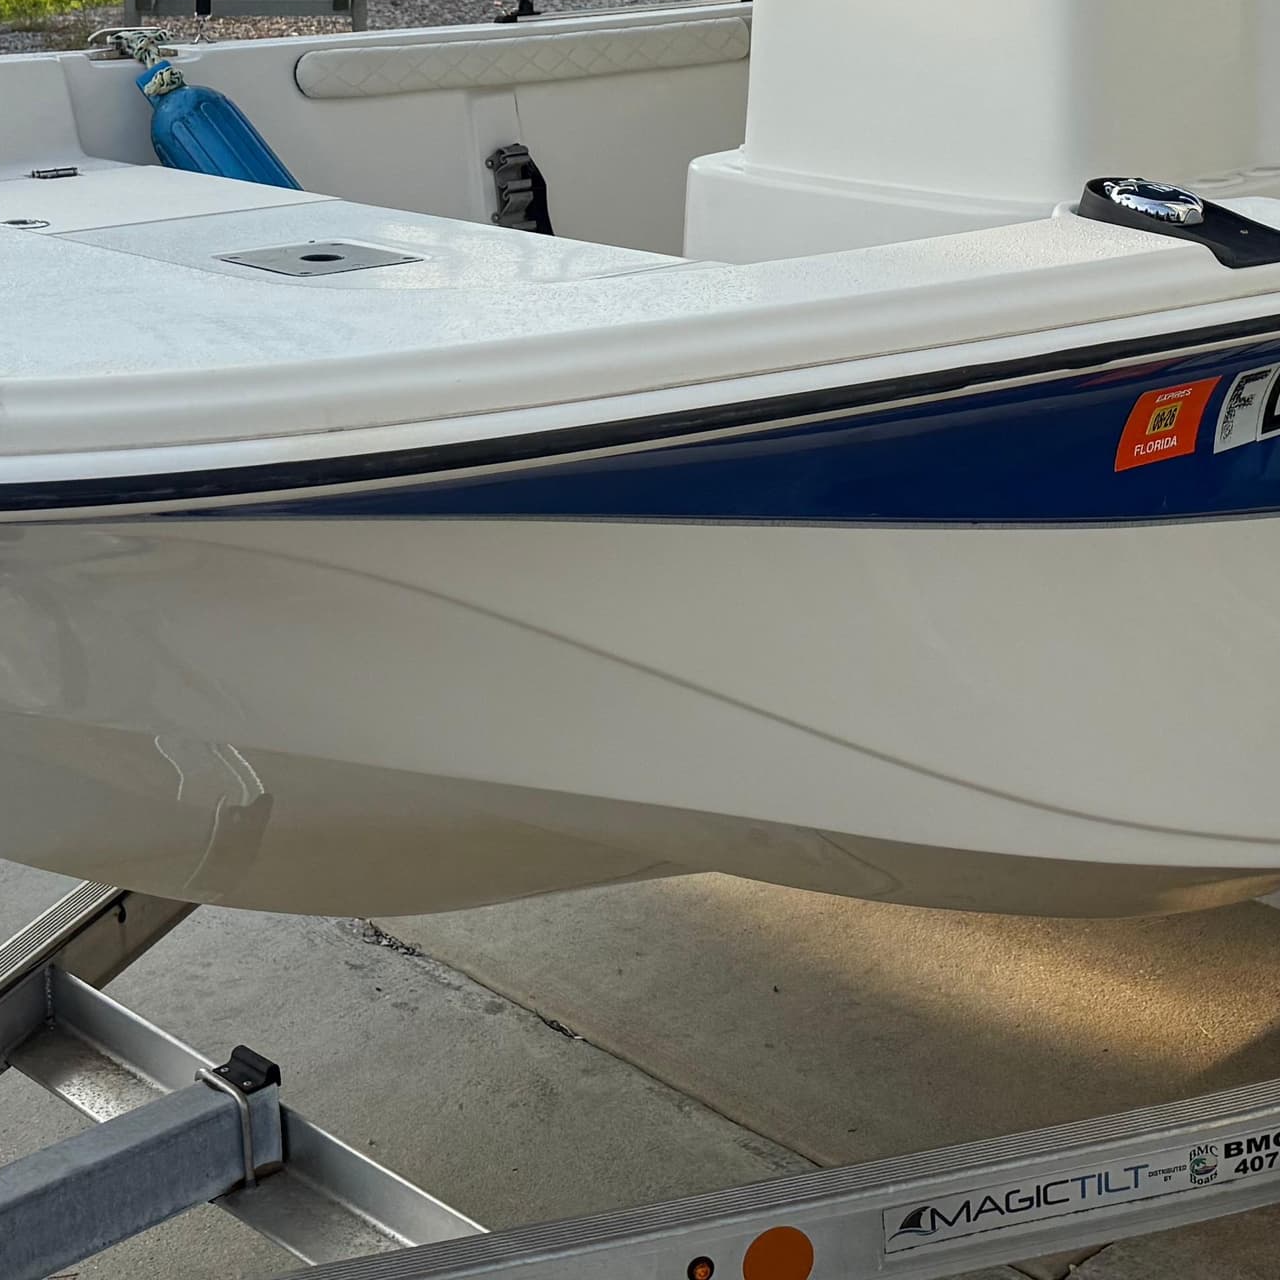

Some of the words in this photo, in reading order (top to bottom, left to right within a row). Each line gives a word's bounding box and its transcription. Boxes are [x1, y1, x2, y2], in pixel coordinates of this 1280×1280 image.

[1155, 388, 1193, 403] EXPIRES
[1133, 436, 1177, 457] FLORIDA
[1189, 1144, 1219, 1160] BMC
[1148, 1165, 1187, 1178] DISTRIBUTED
[1189, 1171, 1219, 1186] Boats
